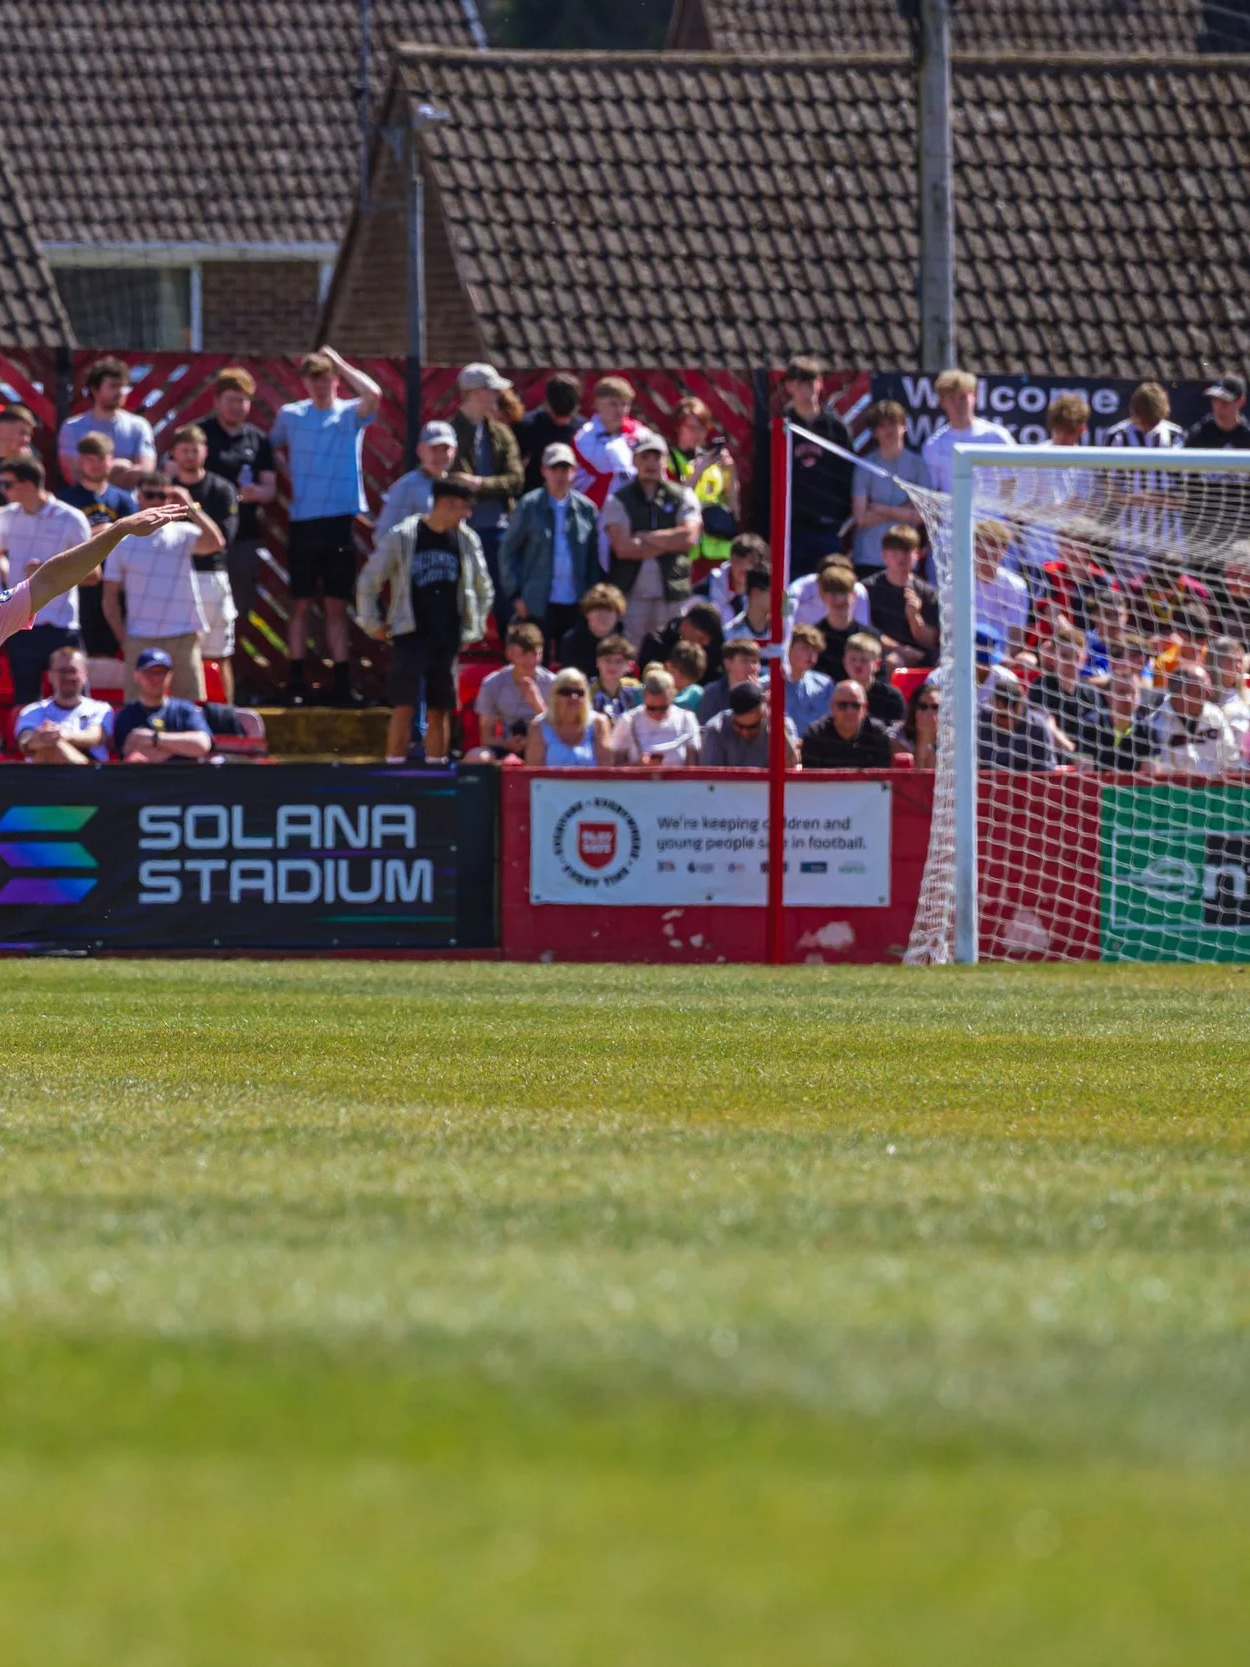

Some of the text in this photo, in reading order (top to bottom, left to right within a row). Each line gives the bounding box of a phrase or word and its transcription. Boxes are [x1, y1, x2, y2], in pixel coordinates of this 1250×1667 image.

[901, 376, 1120, 414] Wlcoe
[138, 804, 417, 849] SOLANA
[656, 814, 851, 833] We're keeping cldren and
[656, 838, 702, 853] young
[705, 836, 754, 853] people
[792, 836, 805, 850] in
[809, 836, 866, 851] football.
[138, 859, 434, 904] STADIUM
